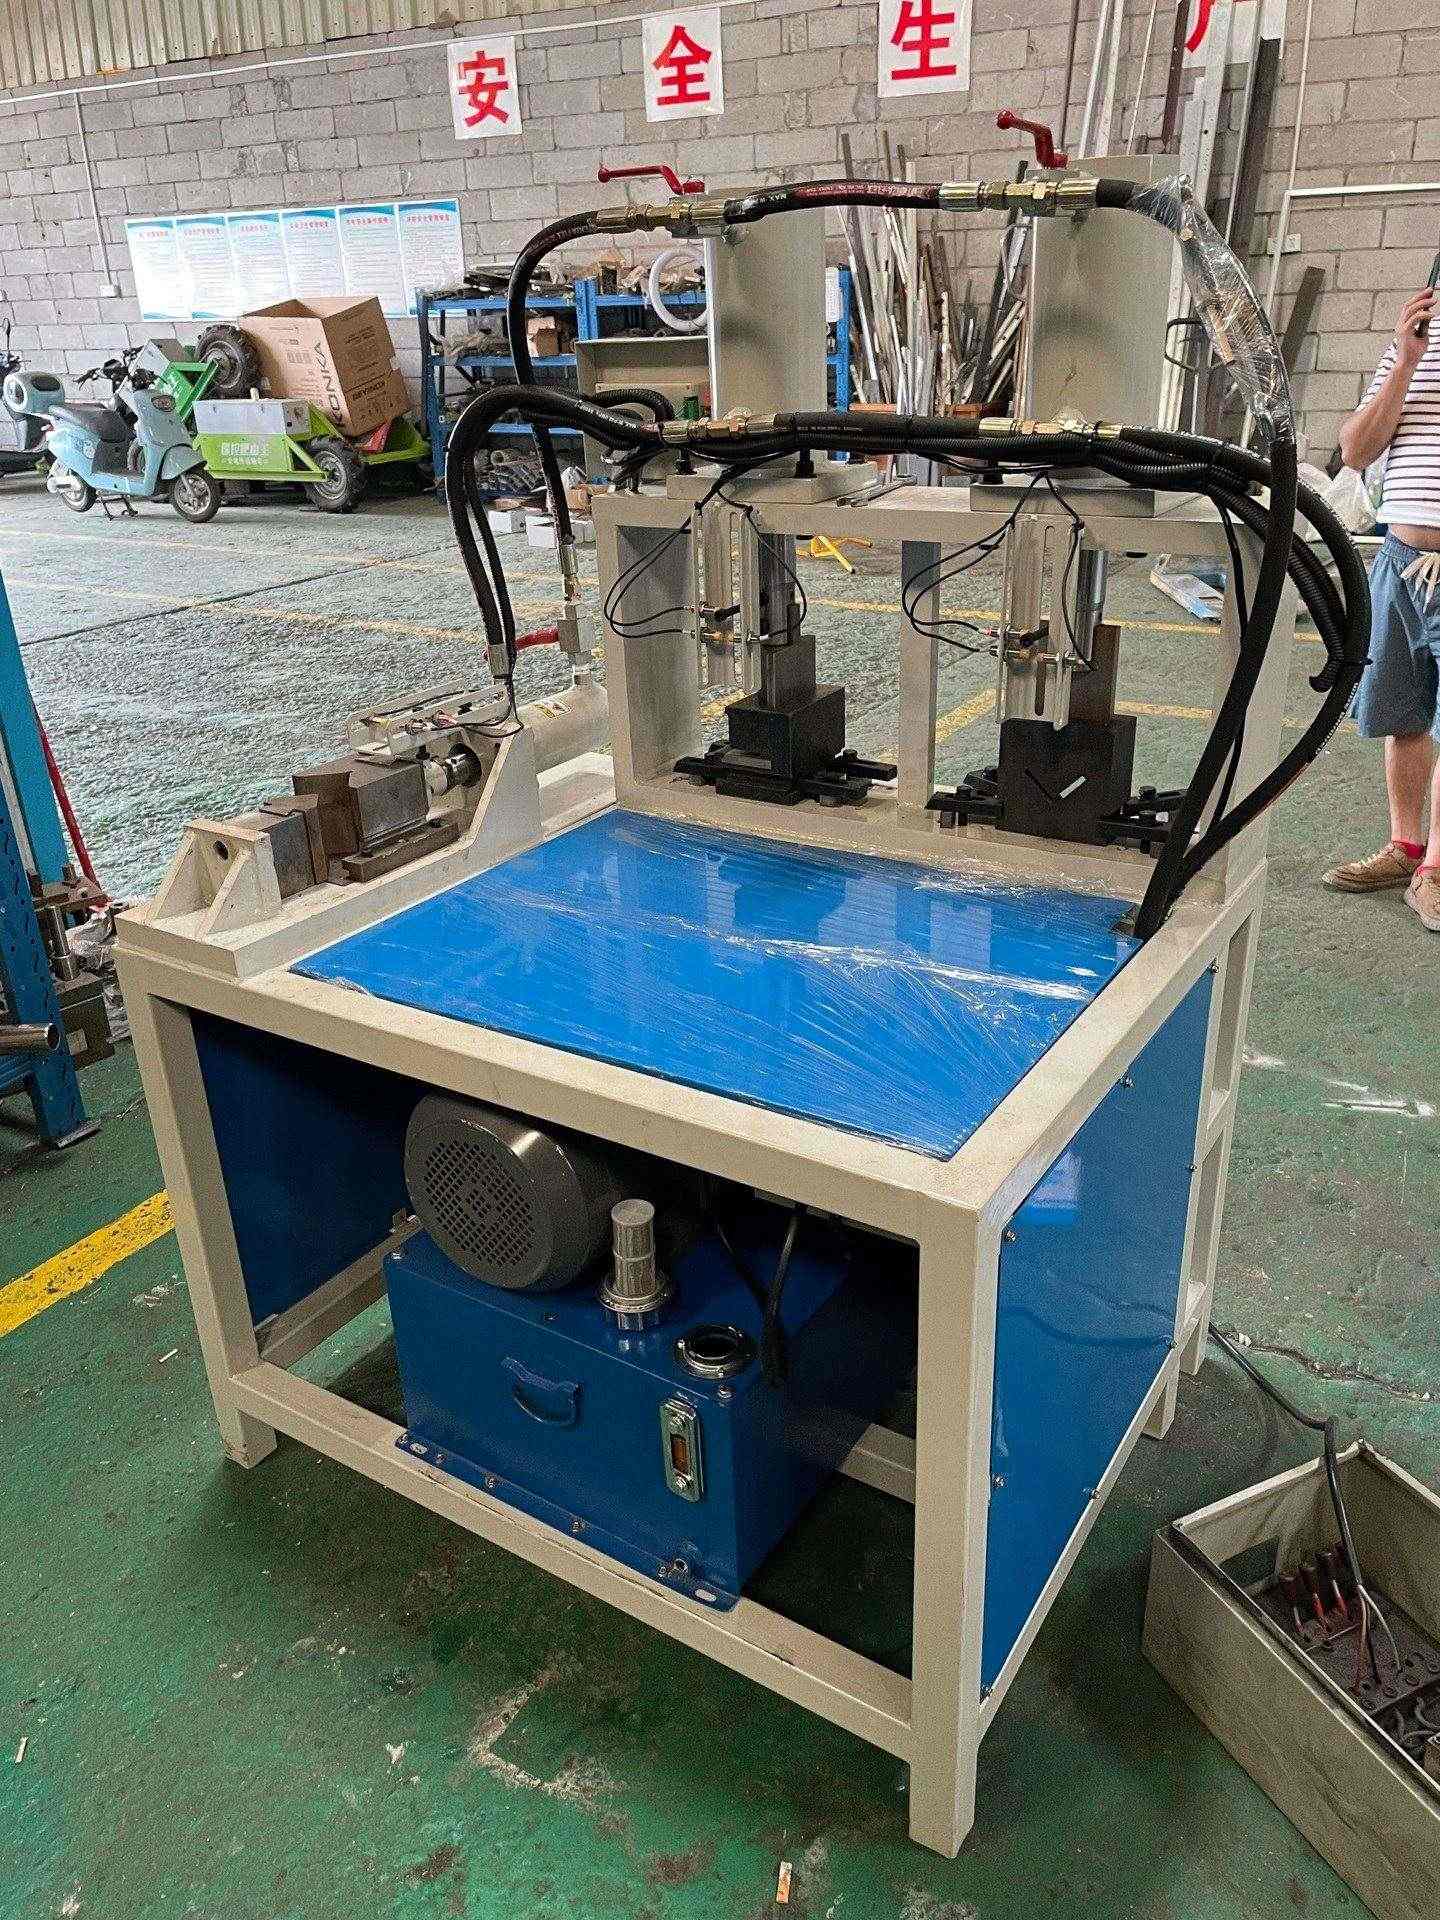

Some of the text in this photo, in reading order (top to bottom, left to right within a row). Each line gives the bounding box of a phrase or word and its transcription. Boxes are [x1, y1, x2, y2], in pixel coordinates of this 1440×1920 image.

[459, 0, 957, 127] 安 全 生
